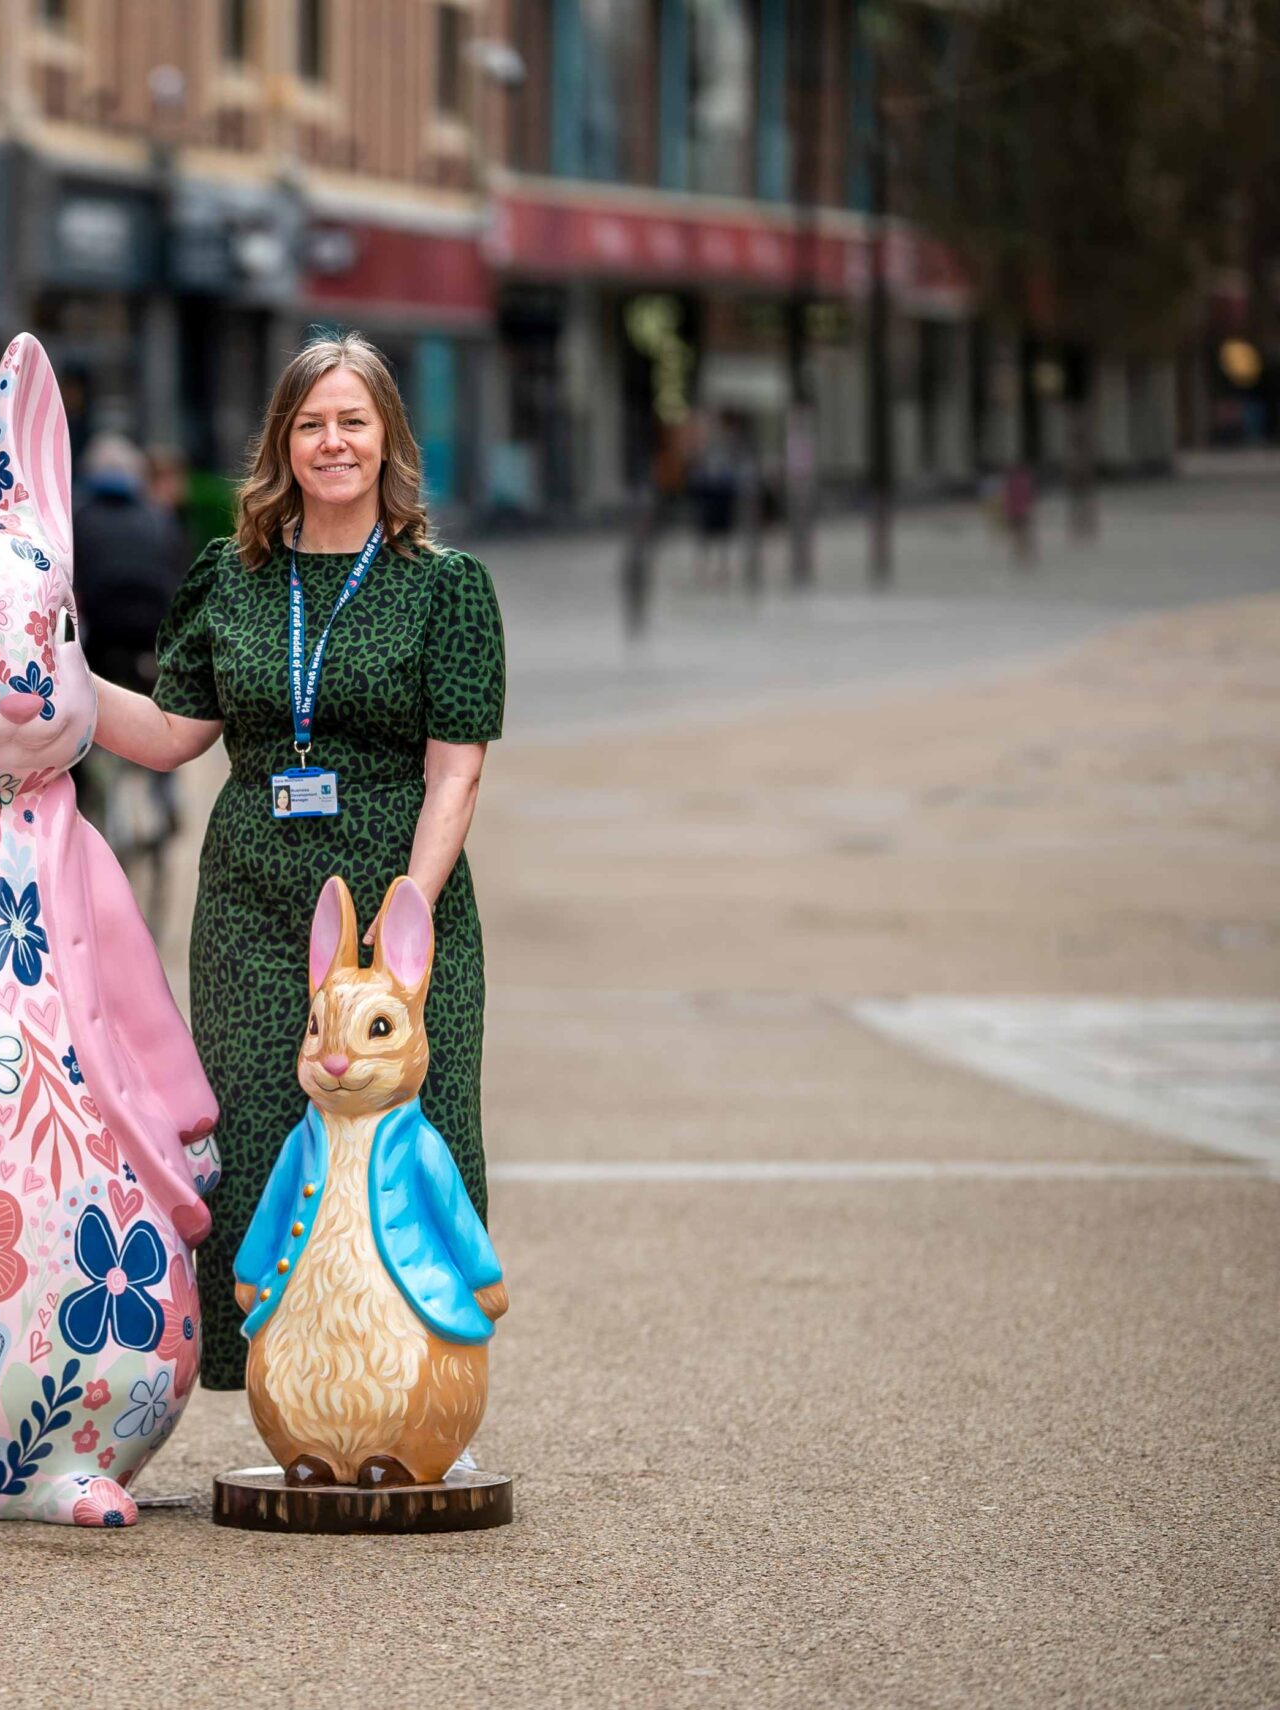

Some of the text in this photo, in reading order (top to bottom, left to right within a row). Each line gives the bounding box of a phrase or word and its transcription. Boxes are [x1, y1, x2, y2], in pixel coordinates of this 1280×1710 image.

[353, 563, 365, 577] the
[361, 543, 375, 564] great
[293, 590, 301, 604] the
[291, 605, 302, 628] great
[293, 629, 302, 658] waddle
[292, 659, 302, 668] of
[306, 671, 317, 695] great
[301, 697, 312, 713] the
